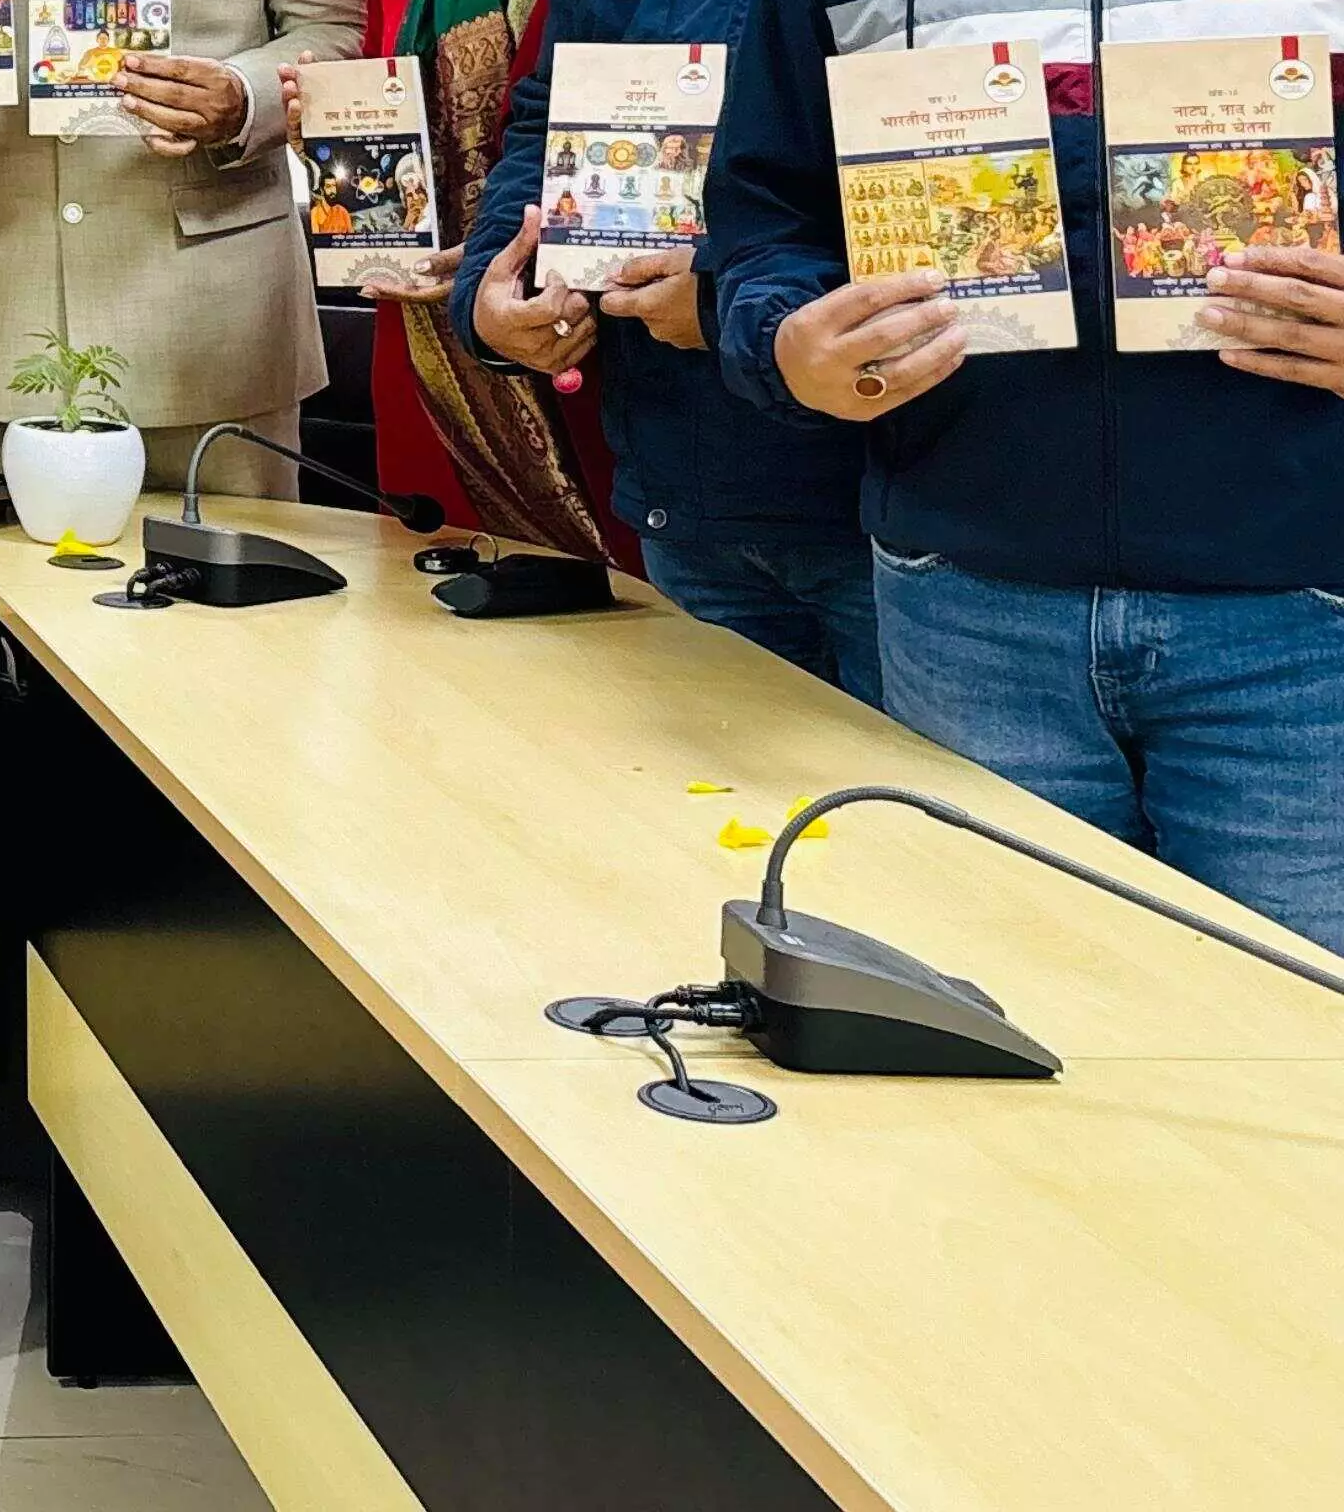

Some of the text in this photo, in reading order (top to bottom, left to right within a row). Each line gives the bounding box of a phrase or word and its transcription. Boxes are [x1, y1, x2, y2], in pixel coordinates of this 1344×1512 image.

[881, 110, 930, 128] भारतीय
[1174, 117, 1272, 136] भारतीय चेतना
